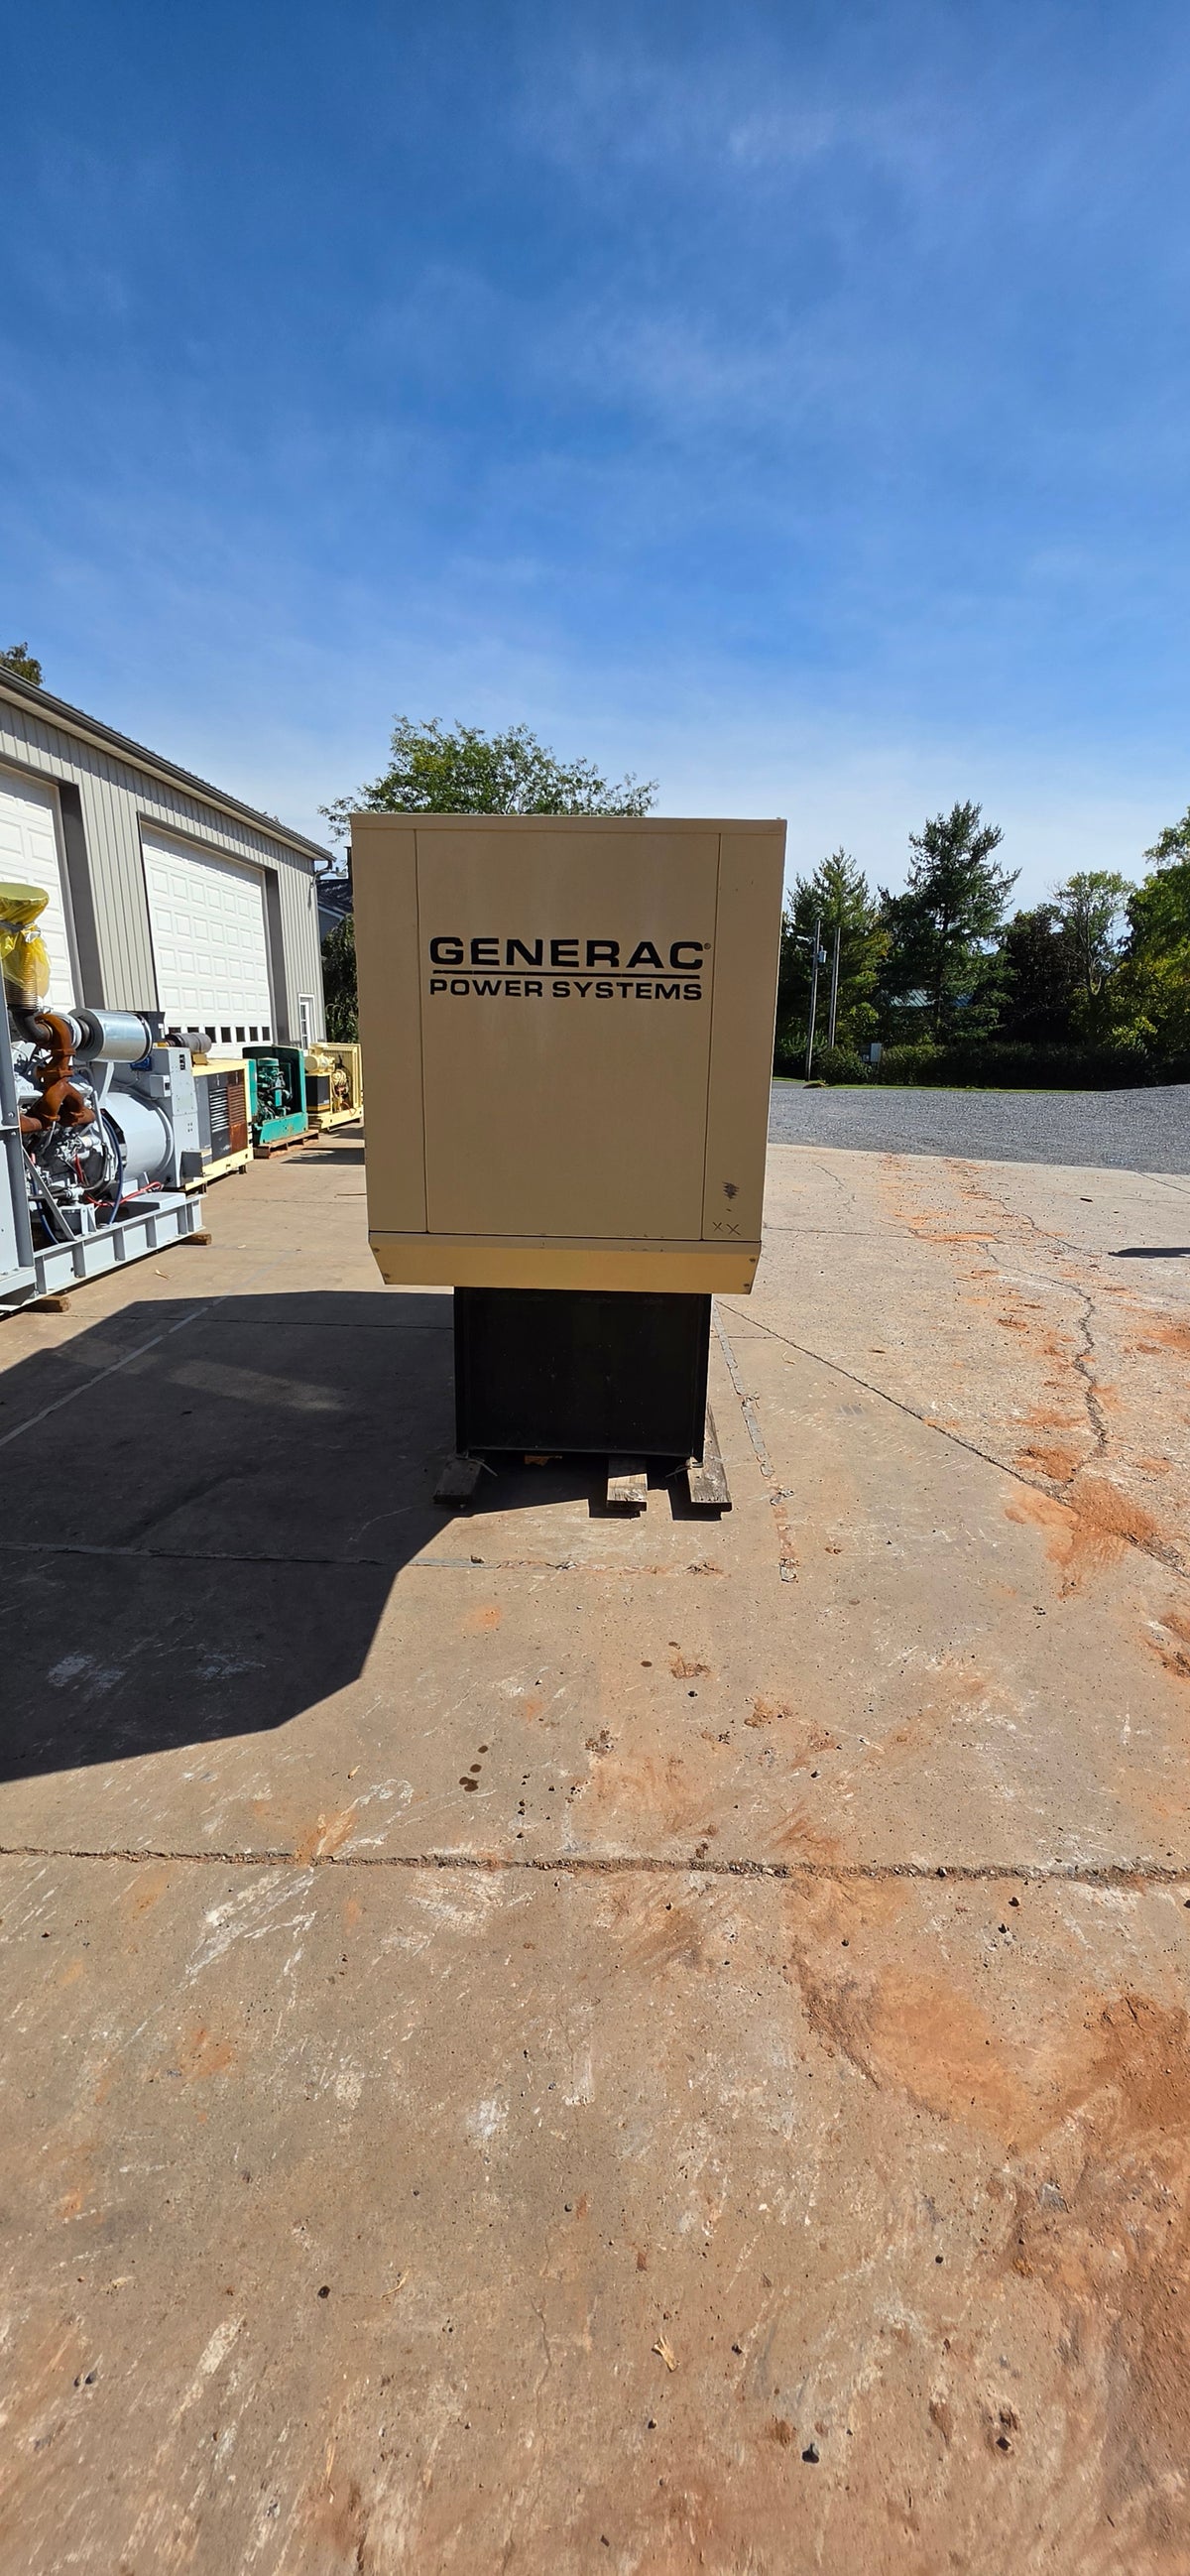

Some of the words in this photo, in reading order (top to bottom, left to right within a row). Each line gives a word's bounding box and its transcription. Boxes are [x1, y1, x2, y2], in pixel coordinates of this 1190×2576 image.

[429, 936, 703, 970] GENERAC
[429, 978, 542, 998] POWER
[552, 980, 702, 1001] SYSTEMS
